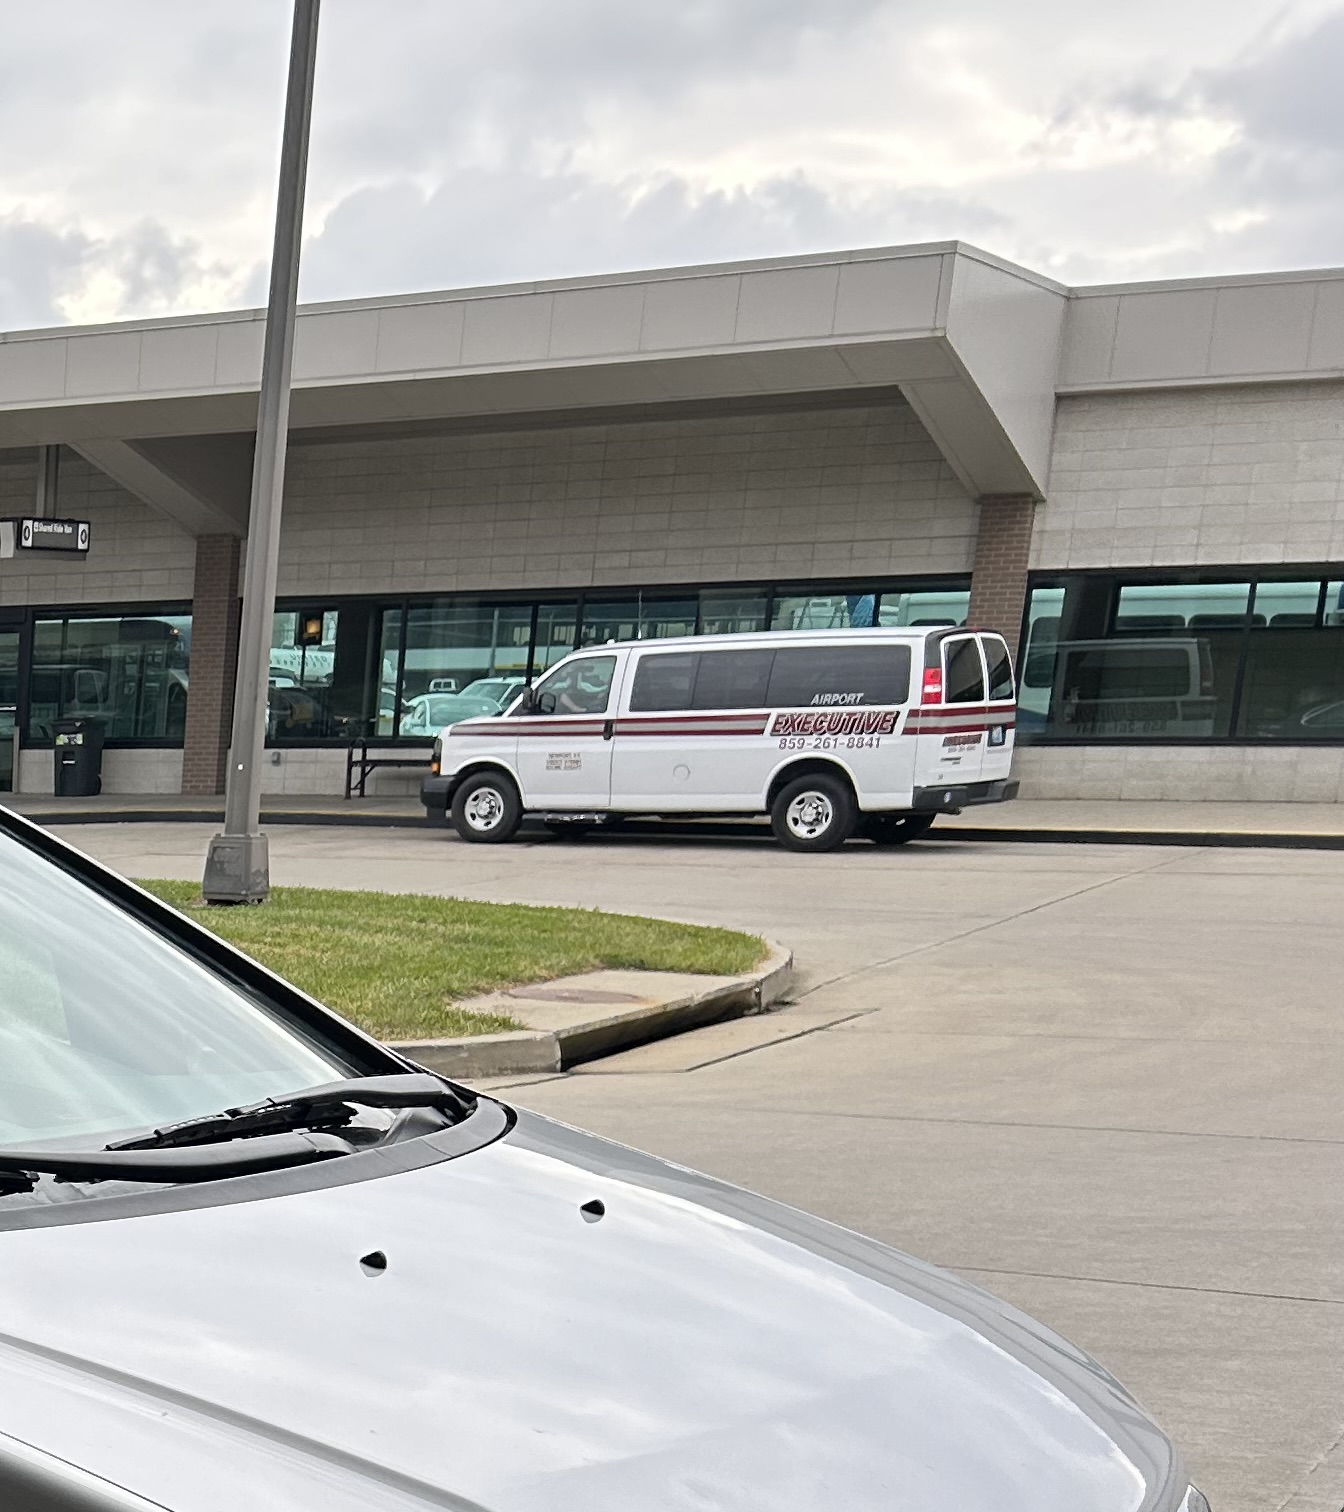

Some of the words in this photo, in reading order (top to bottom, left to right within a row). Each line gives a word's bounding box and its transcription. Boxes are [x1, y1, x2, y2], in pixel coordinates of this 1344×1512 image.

[810, 692, 865, 706] AIRPORT
[770, 709, 900, 736] EXECUTIVE
[778, 736, 881, 750] 859-261-8841
